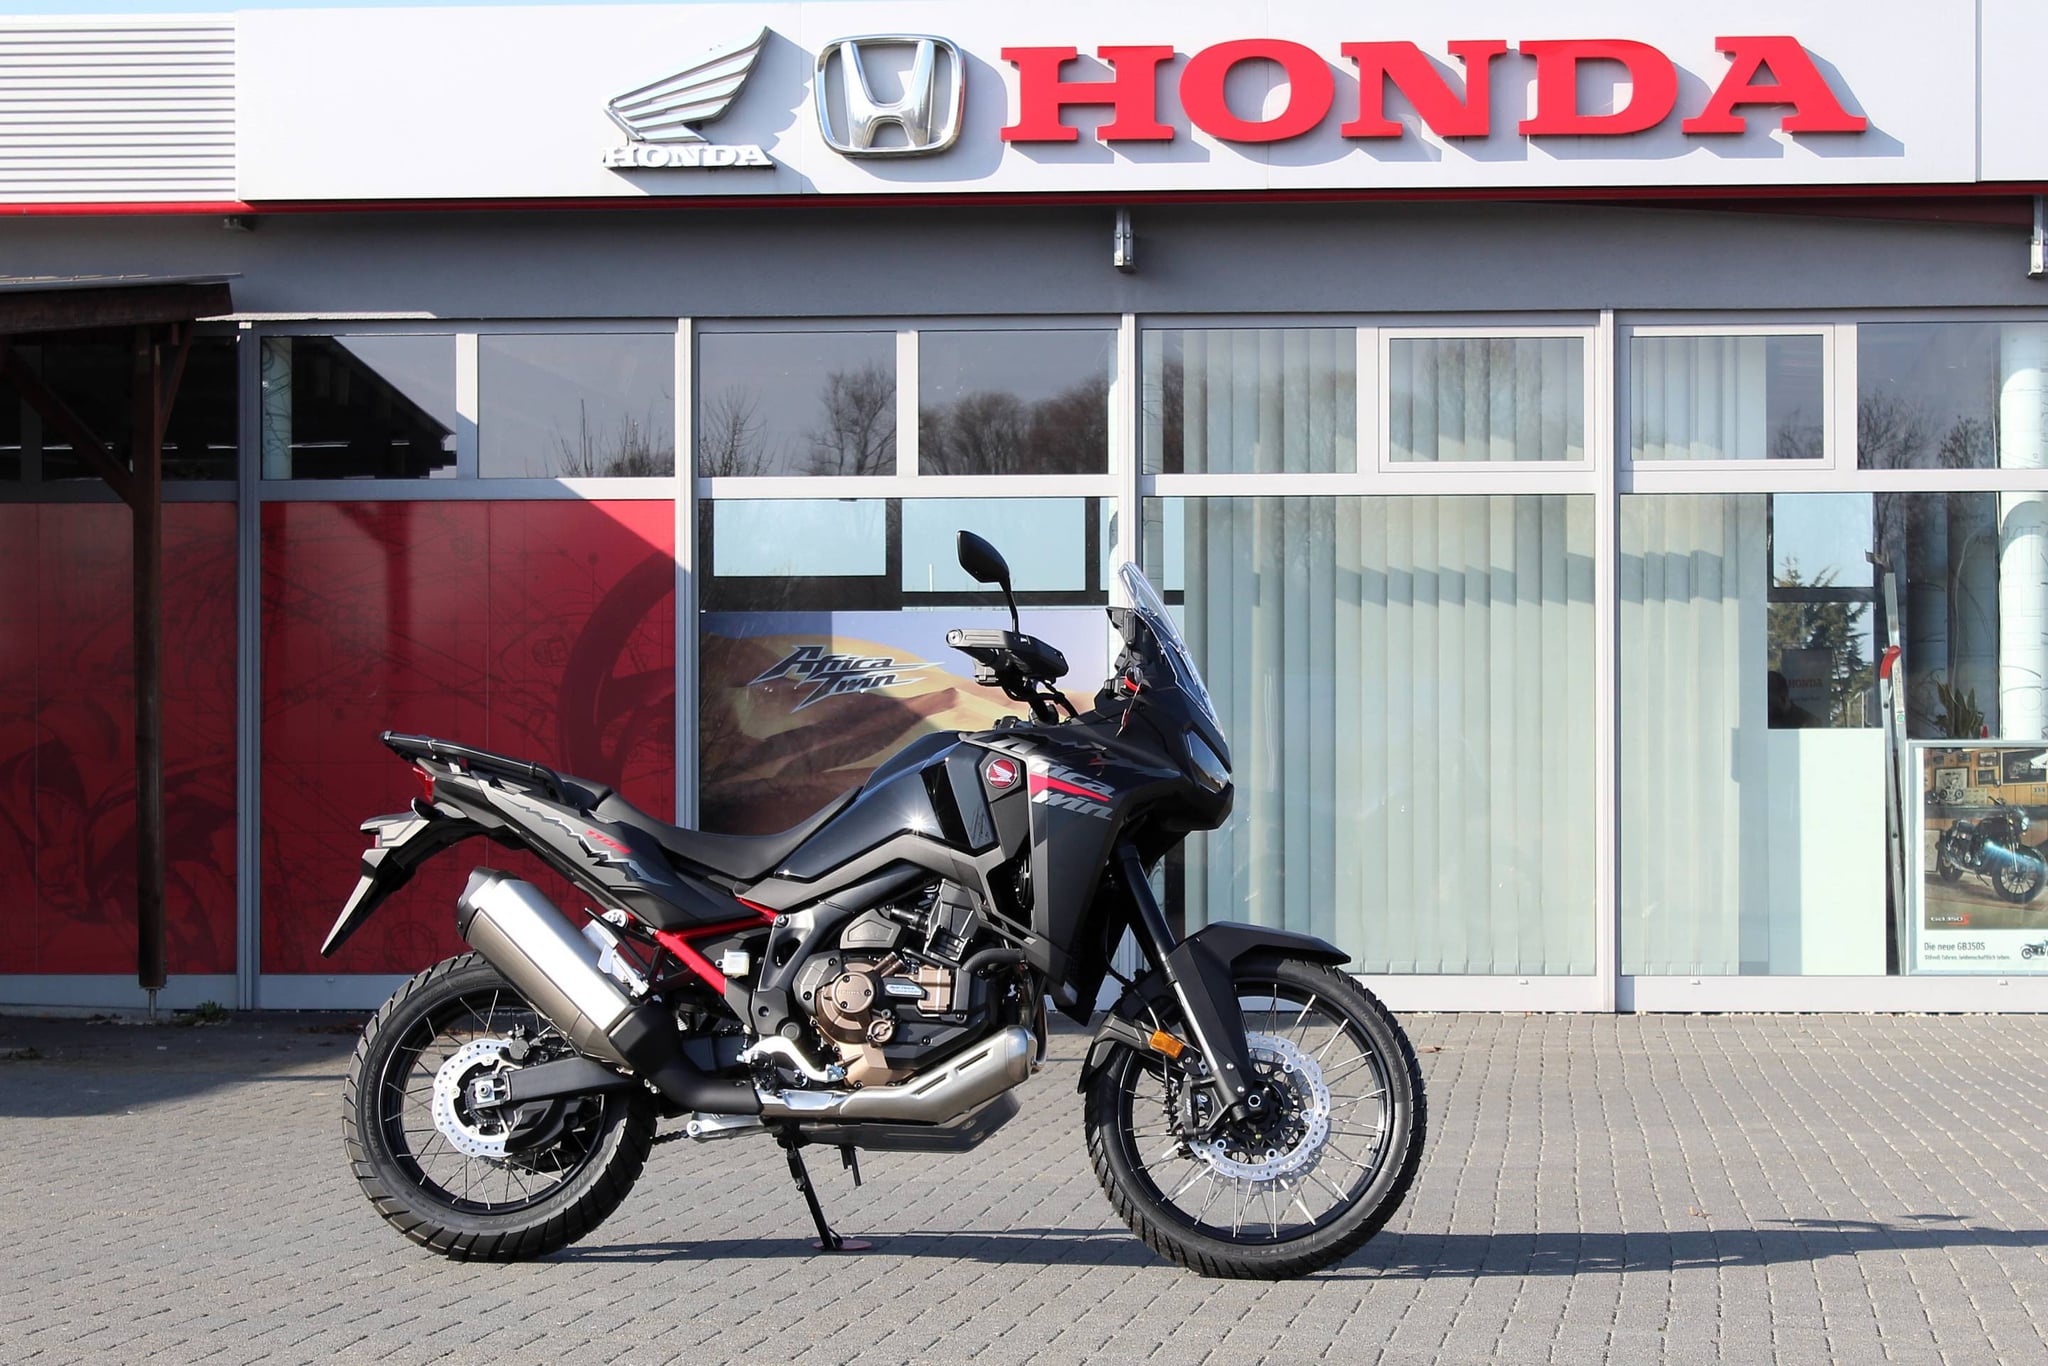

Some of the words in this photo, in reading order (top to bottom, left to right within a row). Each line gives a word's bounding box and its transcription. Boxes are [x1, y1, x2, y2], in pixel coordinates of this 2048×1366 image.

[1000, 35, 1867, 144] HONDA
[603, 144, 775, 168] HONDA
[748, 645, 902, 687] Africa
[790, 671, 902, 713] Twin
[1924, 942, 1936, 951] Die
[1937, 943, 1955, 951] neue
[1957, 942, 1986, 951] GB350S
